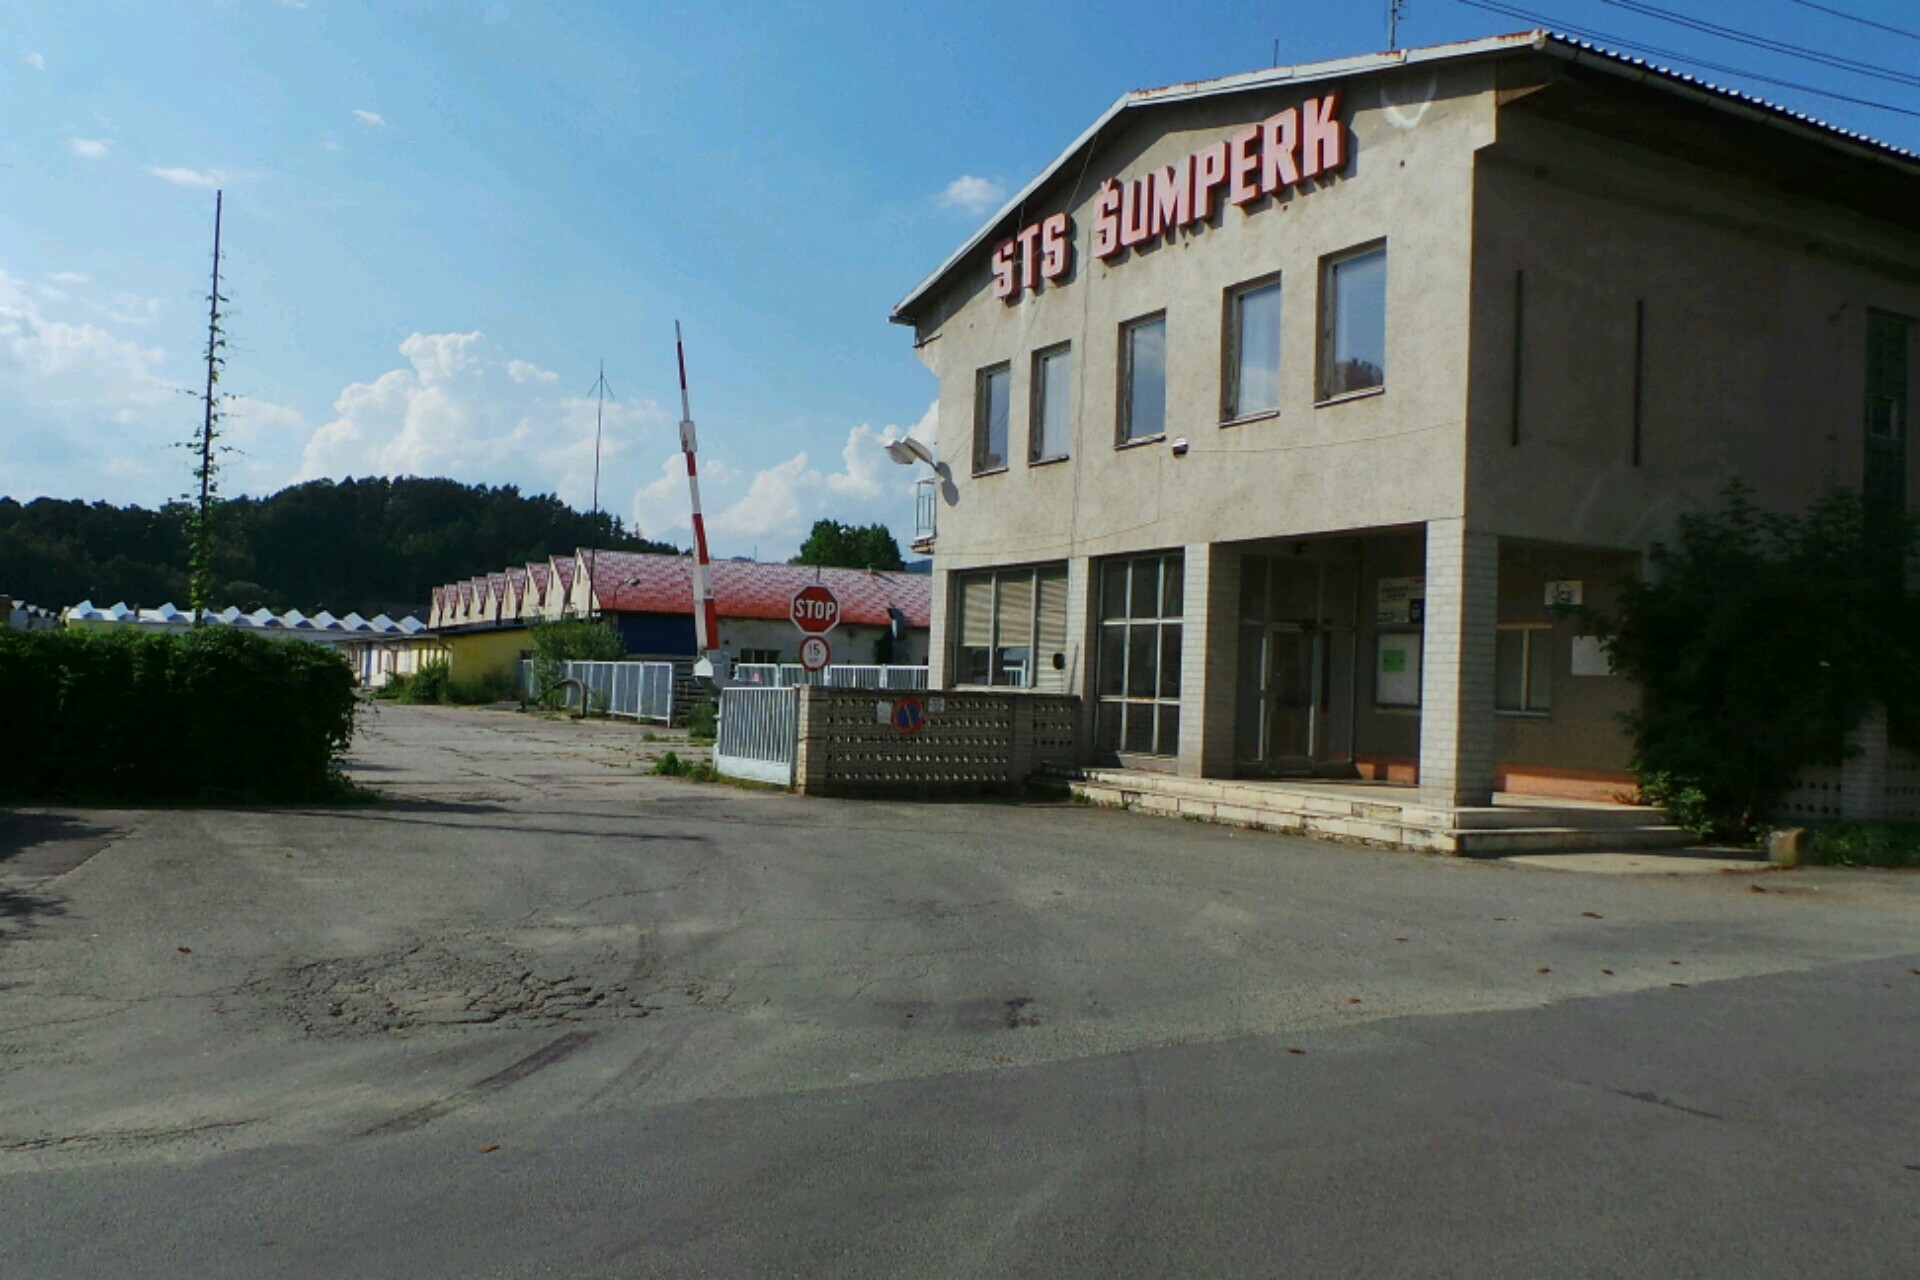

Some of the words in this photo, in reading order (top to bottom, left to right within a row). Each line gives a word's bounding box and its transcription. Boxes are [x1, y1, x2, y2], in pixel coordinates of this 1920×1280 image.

[991, 211, 1071, 301] STS
[1094, 89, 1347, 260] ŠUMPERK
[796, 599, 836, 621] STOP
[809, 644, 821, 656] 15
